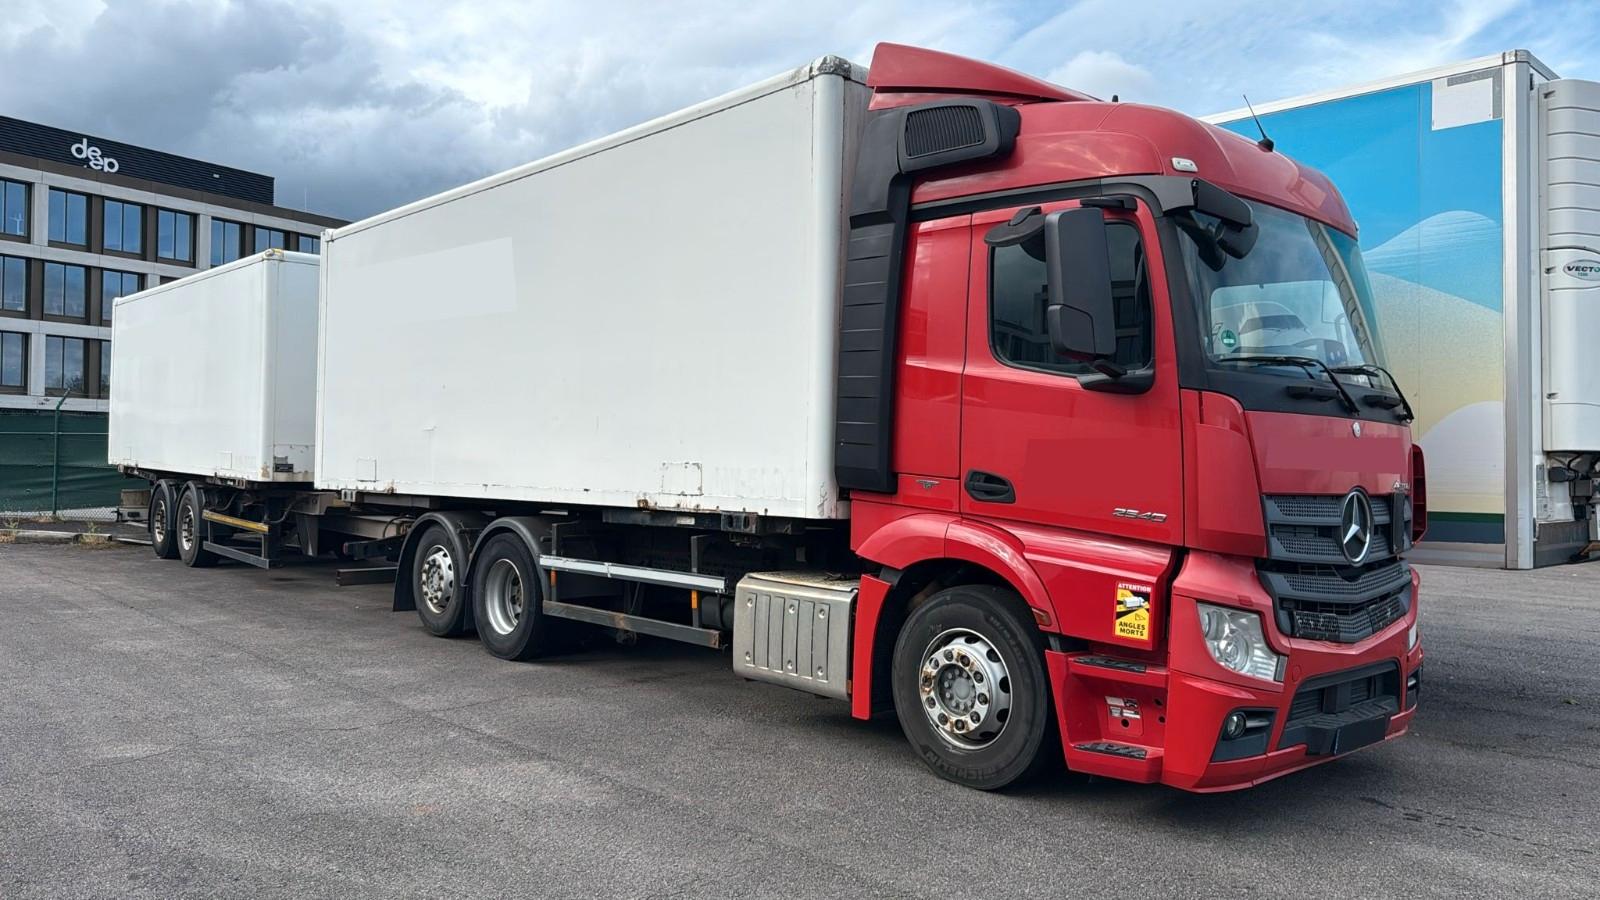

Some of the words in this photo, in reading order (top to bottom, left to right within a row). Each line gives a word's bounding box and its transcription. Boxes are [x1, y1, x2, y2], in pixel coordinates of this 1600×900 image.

[1118, 583, 1151, 592] ATTENTION
[1119, 621, 1145, 630] ANGLES
[1120, 628, 1144, 636] MORTS
